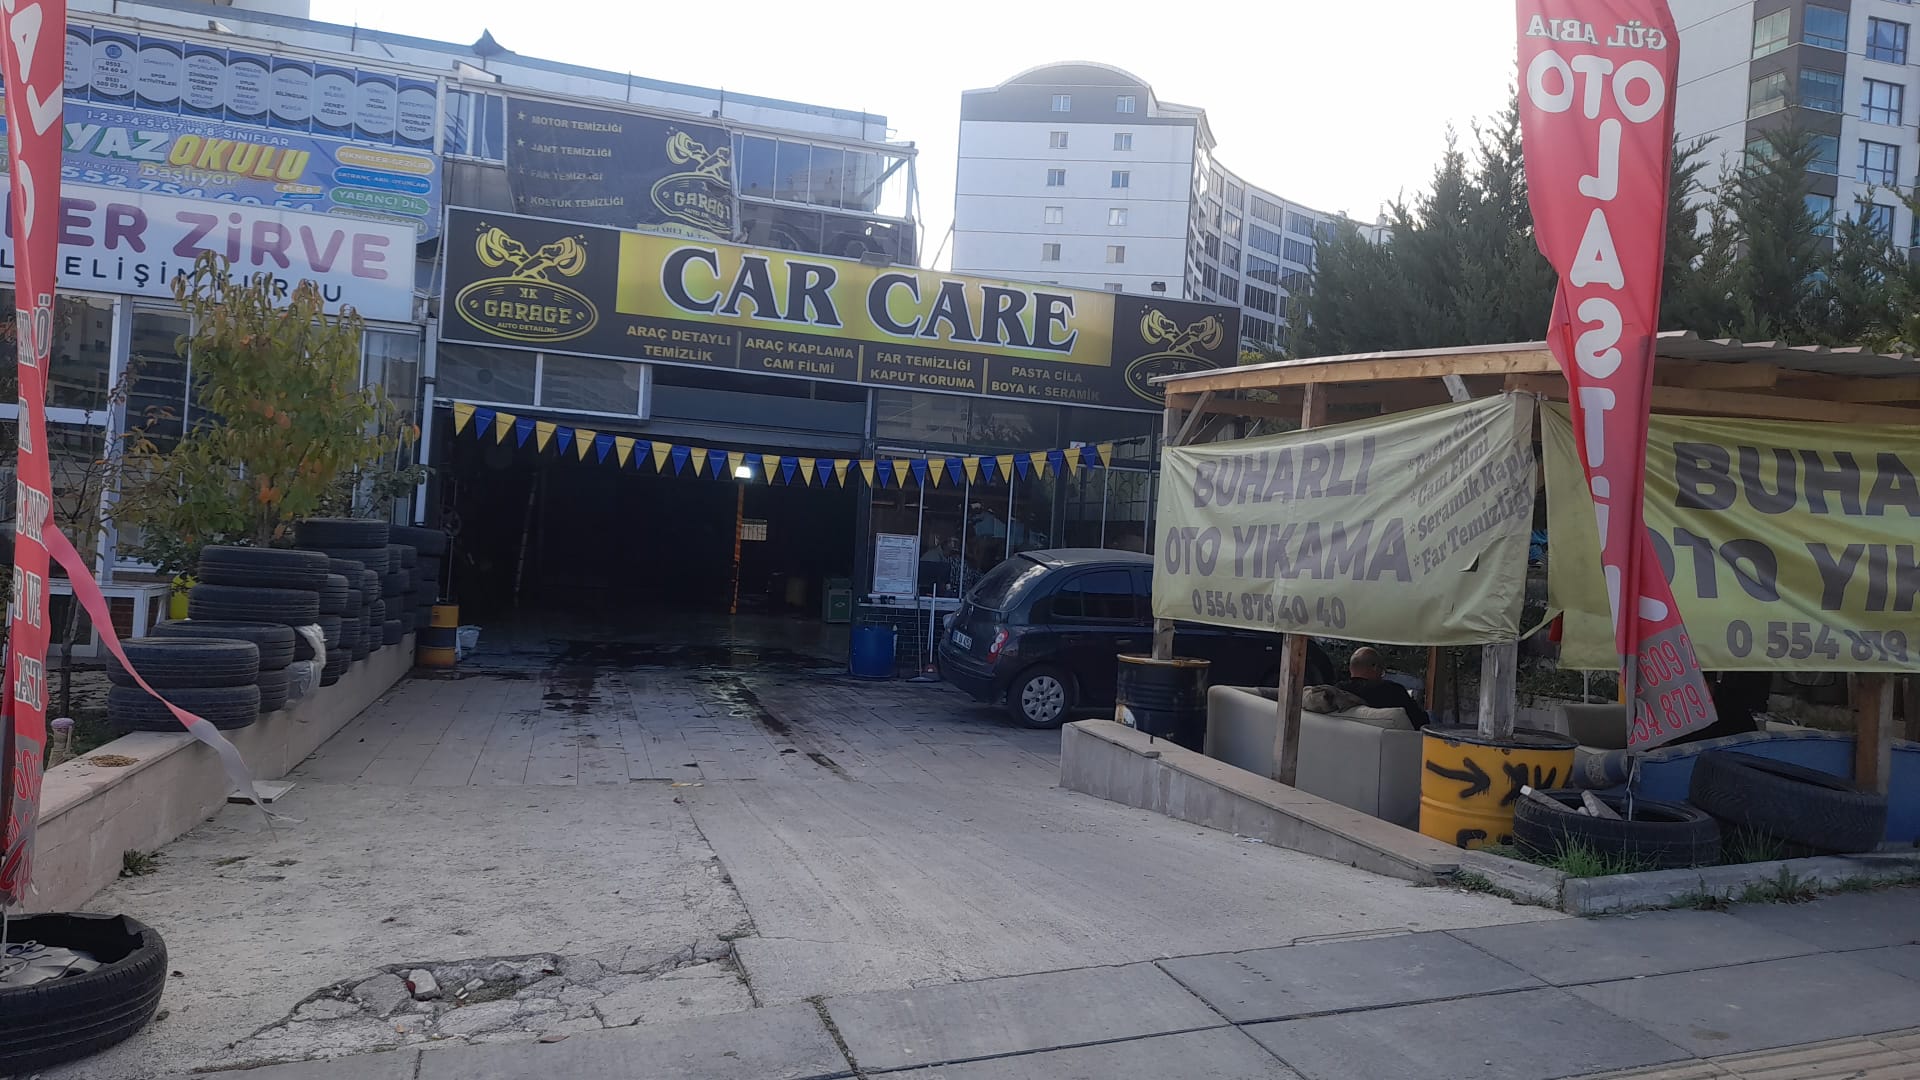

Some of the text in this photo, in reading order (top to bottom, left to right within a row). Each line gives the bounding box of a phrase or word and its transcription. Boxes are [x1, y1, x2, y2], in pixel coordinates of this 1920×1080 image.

[531, 115, 623, 134] MOTOR TEMİZLİĞİ
[224, 130, 289, 147] SINIFLAR
[63, 122, 311, 183] YAZ OKULU
[531, 143, 612, 158] JANT TEMİZLİĞİ
[142, 163, 238, 187] Başlıyor
[338, 190, 398, 206] YABANCI
[530, 195, 624, 208] KOLTUK TEMİZLİĞİ
[5, 194, 147, 253] ER
[484, 299, 573, 324] GARAGE
[659, 246, 1079, 355] CAR CARE
[497, 322, 518, 331] AUTO
[626, 324, 731, 347] ARAÇ DETAYLI
[643, 344, 713, 362] TEMİZLİK
[745, 337, 854, 359] ARAÇ KAPLAMA
[763, 356, 835, 374] CAM FİLMİ
[876, 352, 972, 372] FAR TEMİZLİĞİ
[870, 368, 976, 389] KAPUT KORUMA
[1011, 366, 1083, 383] PASTA CİLA
[991, 380, 1102, 401] BOYA K. SERAMİK
[1191, 435, 1376, 509] BUHARLI
[1417, 472, 1481, 541] Seramik
[1164, 517, 1413, 583] OTO YIKAMA
[1421, 543, 1448, 576] Far
[1192, 587, 1347, 630] 0 554 879 40 40
[1726, 619, 1753, 658] 0
[1765, 621, 1840, 662] 554
[1639, 640, 1686, 687] 609
[1628, 701, 1664, 745] 54
[1659, 683, 1708, 730] 879
